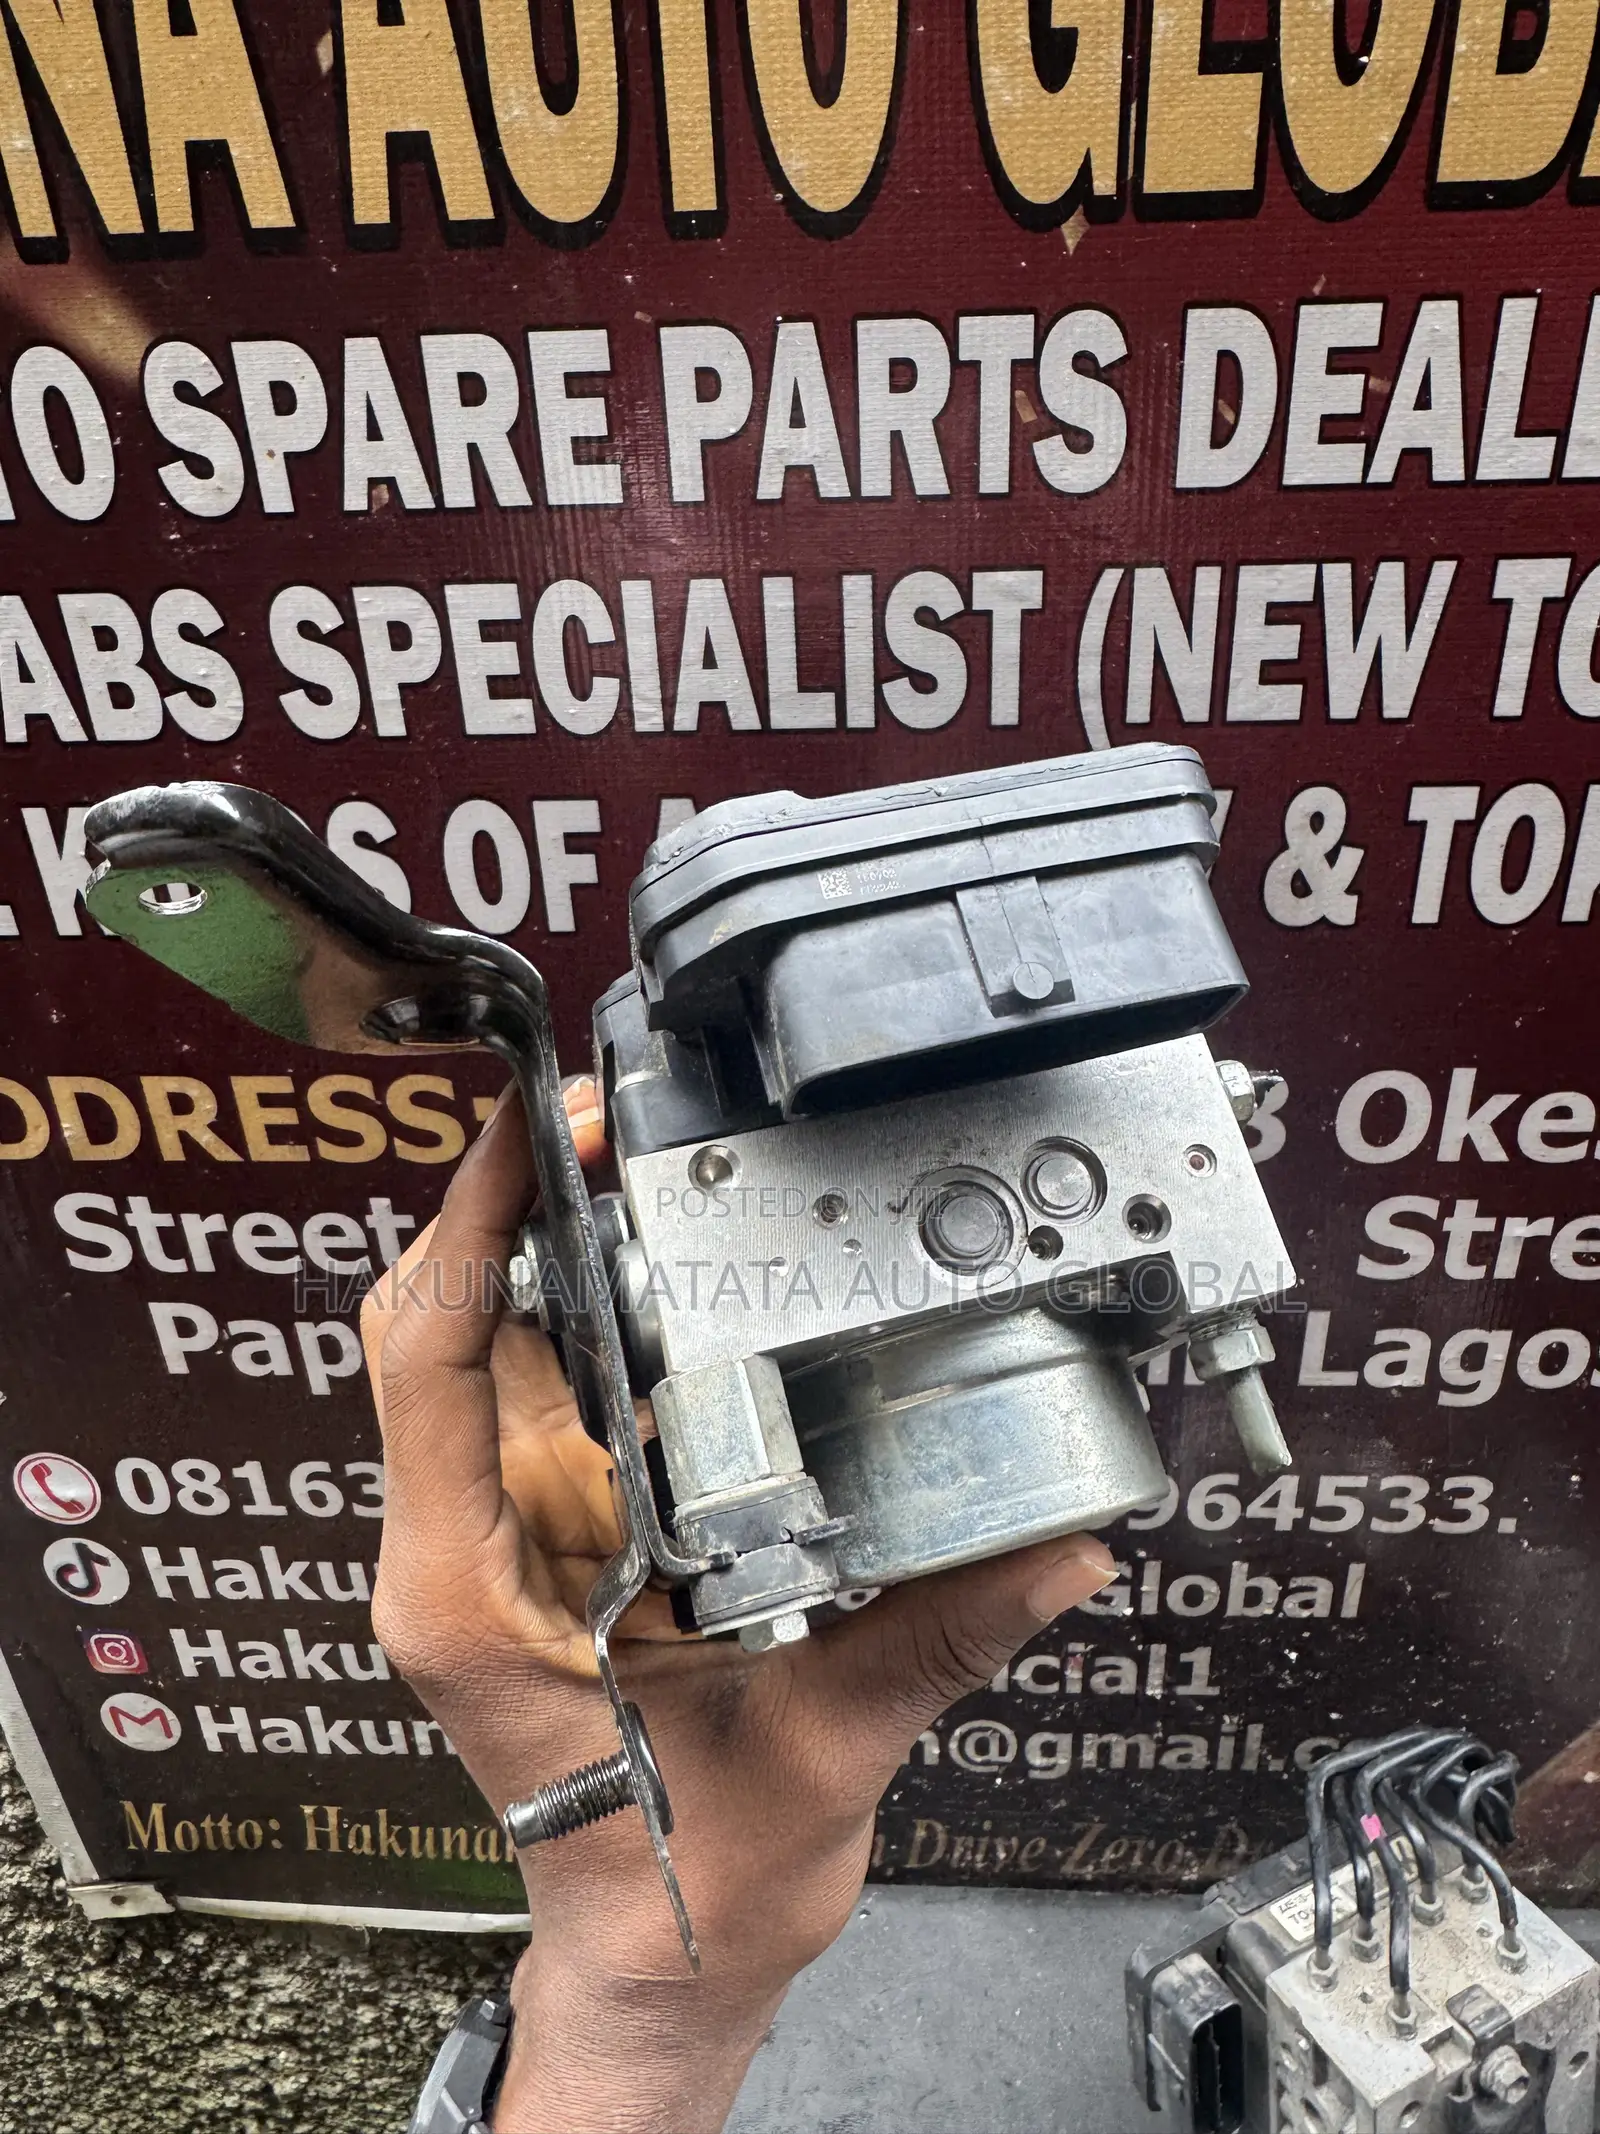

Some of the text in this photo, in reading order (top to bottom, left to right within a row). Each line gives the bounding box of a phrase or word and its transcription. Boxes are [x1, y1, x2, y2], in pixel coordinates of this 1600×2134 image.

[340, 0, 900, 226] AUTO
[976, 0, 1600, 205] GLOB
[143, 328, 624, 518] SPARE
[659, 308, 1128, 502] PARTS
[0, 588, 244, 742] ABS
[268, 569, 1043, 741] SPECIALIST
[1077, 559, 1458, 751] (NEW
[443, 799, 601, 935] OF
[1263, 785, 1364, 926] &
[1335, 1067, 1600, 1164] Oke
[53, 1191, 1600, 1281] Street Stre
[147, 1301, 363, 1396] Pap
[1297, 1310, 1600, 1407] Lago
[114, 1456, 384, 1519] 08163
[119, 1800, 284, 1854] Motto:
[905, 1818, 1048, 1875] Drive
